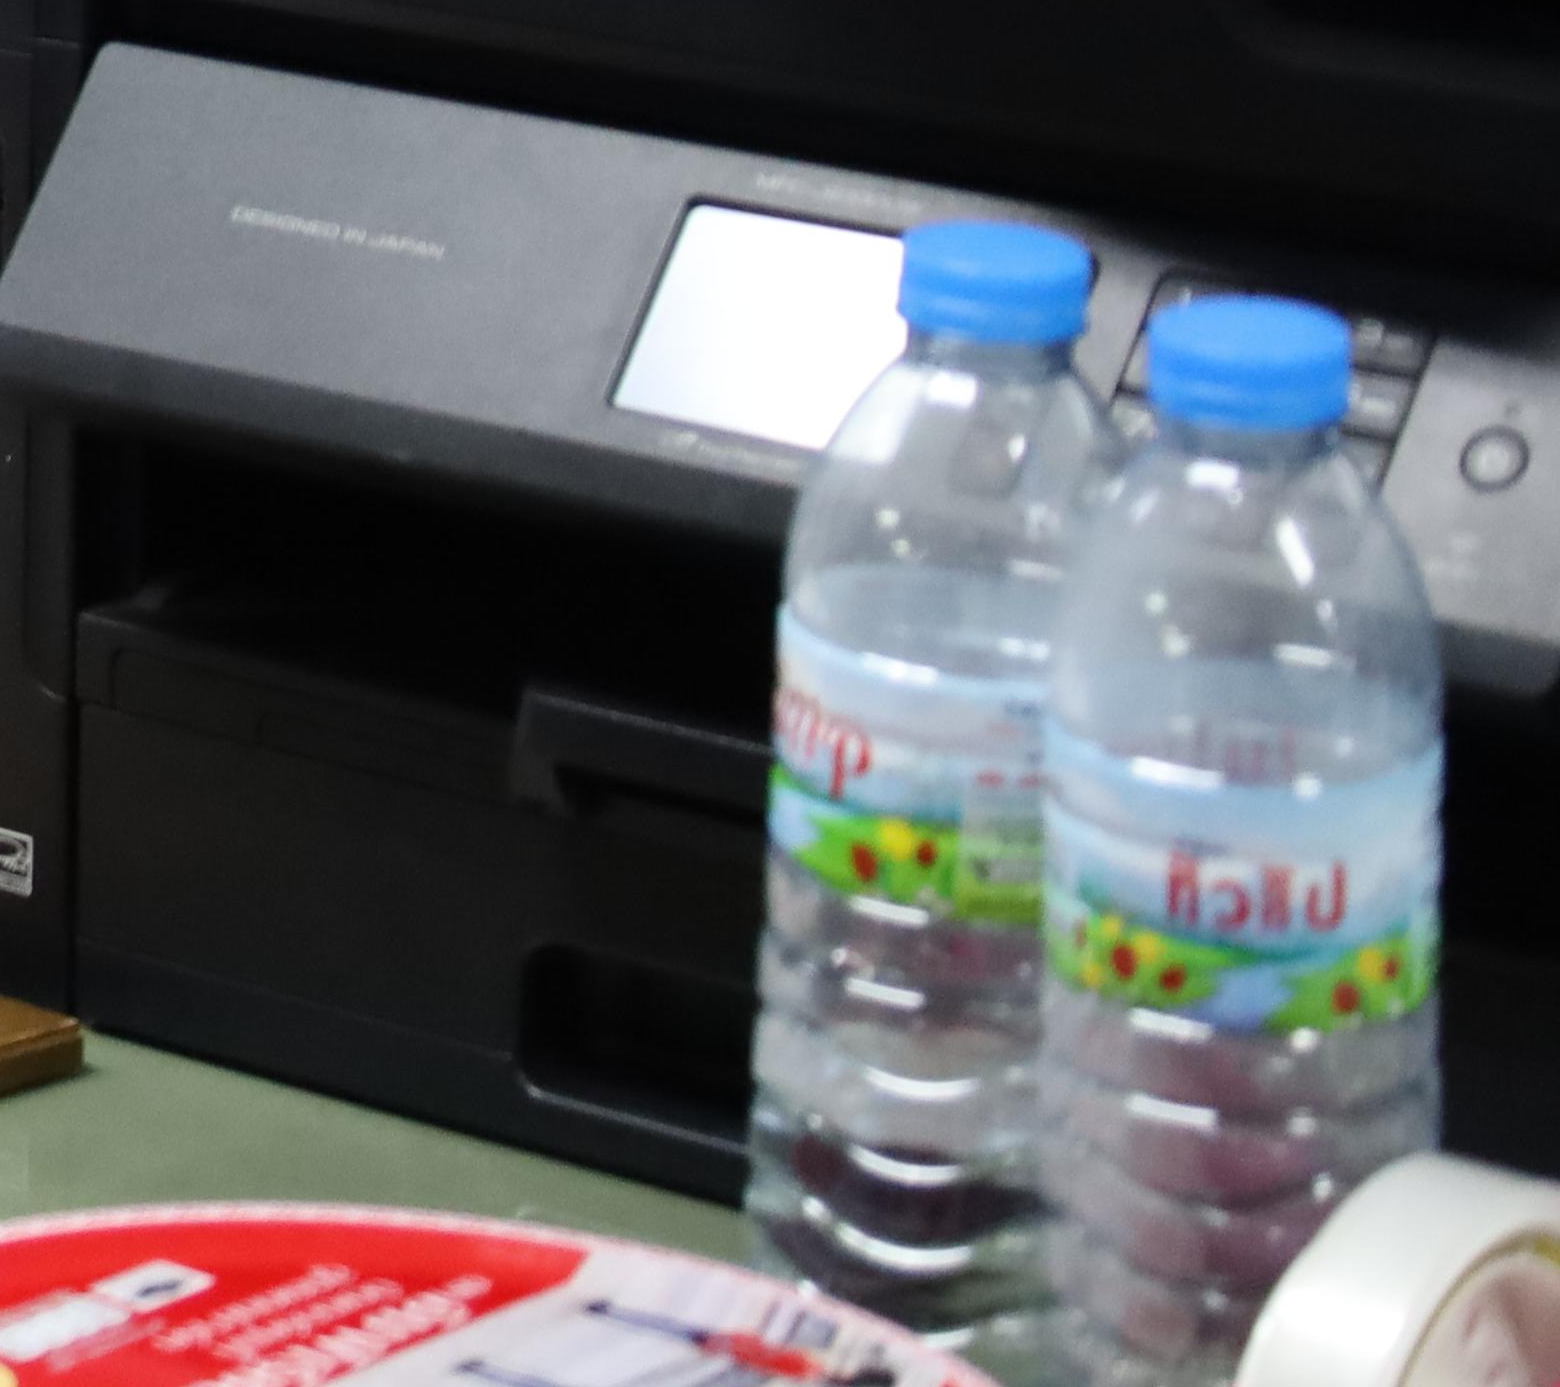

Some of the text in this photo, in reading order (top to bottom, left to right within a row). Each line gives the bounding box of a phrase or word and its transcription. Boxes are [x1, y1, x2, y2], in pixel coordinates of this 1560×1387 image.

[231, 204, 446, 261] DESIGNED IN JAPAN
